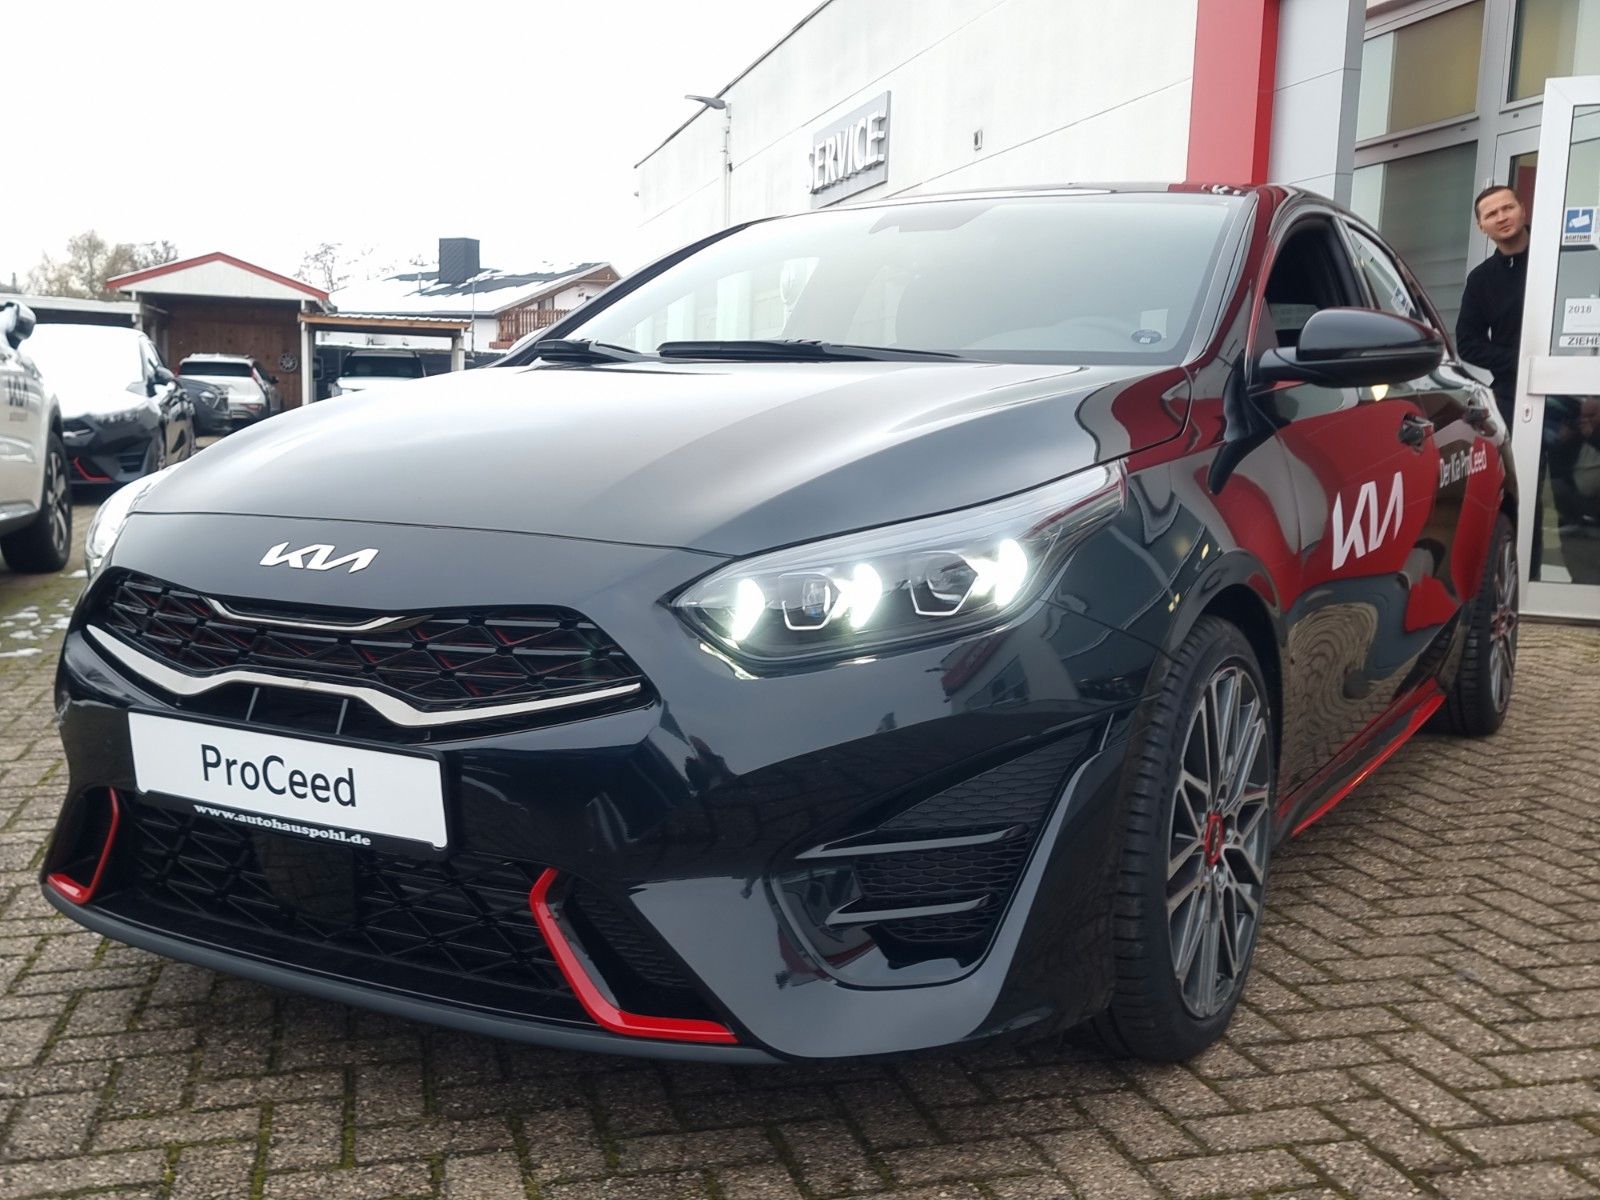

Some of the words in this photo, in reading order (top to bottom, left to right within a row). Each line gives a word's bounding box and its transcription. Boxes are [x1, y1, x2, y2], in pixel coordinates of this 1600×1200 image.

[1568, 304, 1592, 313] 2018
[1332, 470, 1404, 571] KIA
[259, 541, 380, 575] KIA
[201, 743, 357, 808] ProCeed
[193, 804, 372, 846] www.autohauspohl.de
